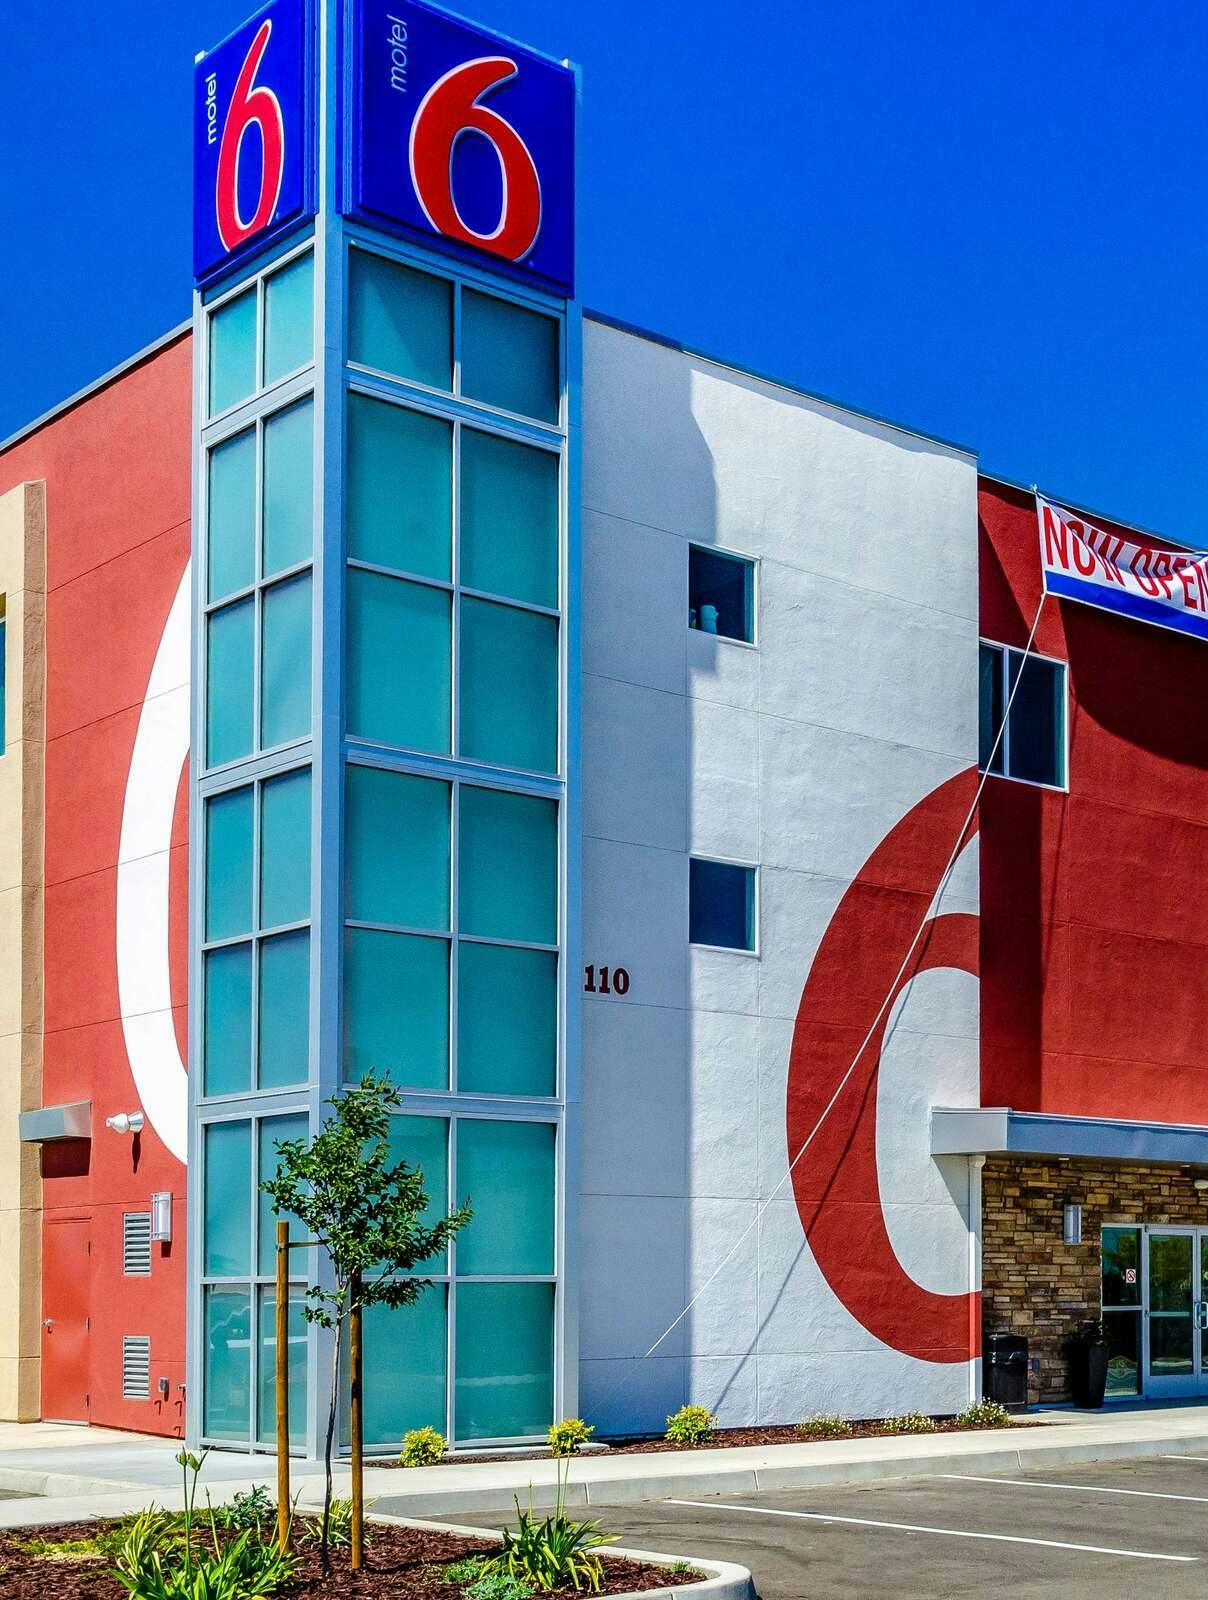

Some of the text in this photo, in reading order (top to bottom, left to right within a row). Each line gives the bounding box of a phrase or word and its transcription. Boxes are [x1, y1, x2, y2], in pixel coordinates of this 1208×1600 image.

[386, 14, 407, 92] motel
[205, 72, 217, 145] motel
[216, 18, 285, 253] 6
[409, 55, 542, 263] 6
[1042, 505, 1126, 588] NOW
[584, 964, 630, 995] 110
